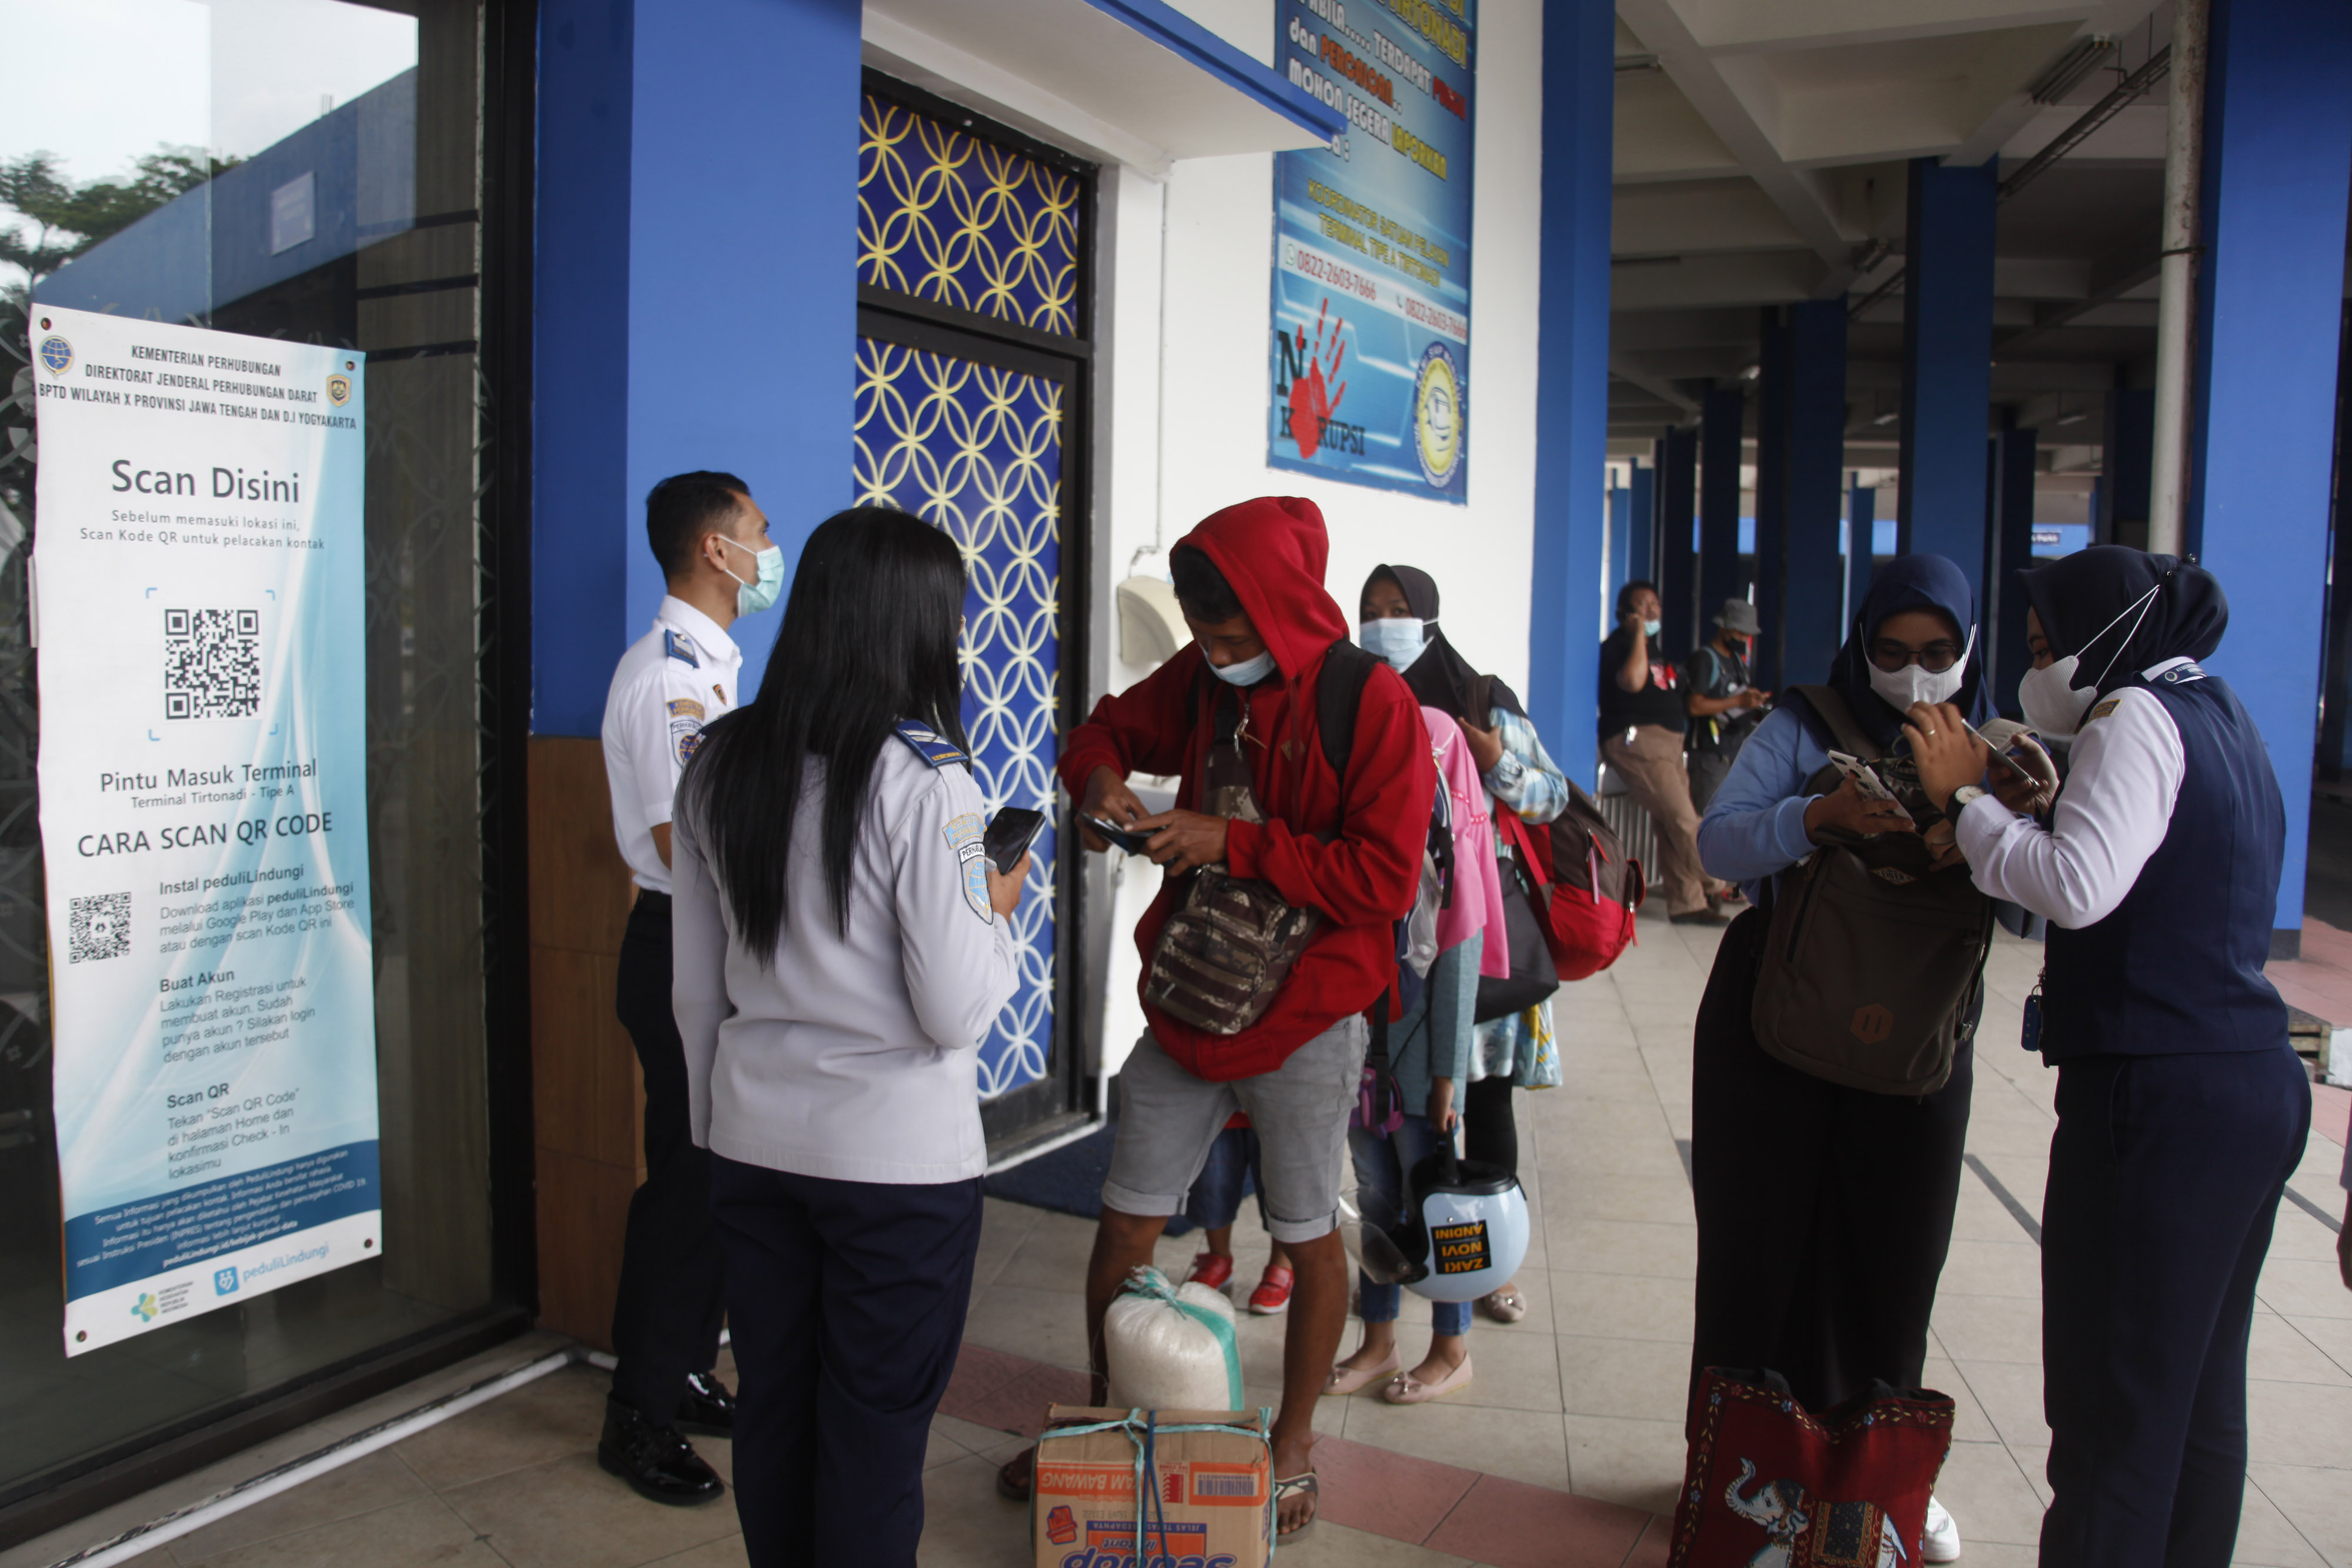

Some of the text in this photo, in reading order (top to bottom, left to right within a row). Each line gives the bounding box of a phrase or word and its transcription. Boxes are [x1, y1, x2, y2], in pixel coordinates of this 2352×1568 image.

[1289, 15, 1317, 57] dan
[1374, 29, 1431, 95] TERDAPAT
[1289, 58, 1343, 113] MOHON
[1347, 93, 1389, 145] SEGERA
[1392, 122, 1447, 182] LAPORKAN
[1308, 178, 1378, 233] KOORDINATOR
[1381, 216, 1412, 249] SATUAN
[1319, 212, 1441, 288] TERMINAL TIPE A TIRTONADI
[1298, 250, 1377, 300] 0822-2603-7666
[132, 345, 281, 376] KEMENTERIAN PERHUBUNGAN
[86, 364, 318, 403] DIREKTORAT JENDERAL PERHUBUNGAN DARAT
[39, 383, 356, 429] BPTD WILAYAH X PROVINSI JAWA TENGAH DAN D.I YOGYAKARTA
[1280, 406, 1365, 456] KRUPSI
[112, 460, 299, 503] Scan Disini
[80, 528, 325, 549] Scan Kode QR untuk pelacakan kontak
[112, 510, 300, 531] Sebelum memasuki lokasi ini,
[101, 759, 316, 792] Pintu Masuk Terminal
[131, 784, 295, 808] Terminal Tirtonadi Tipe A
[78, 812, 333, 857] CARA SCAN QR CODE
[160, 864, 304, 895] Instal peduliLindungi
[160, 882, 353, 920] Download aplikasi peduliLindungi
[160, 898, 355, 937] melalui Google Play dan App Store
[160, 917, 332, 954] atau dengan scan Kode QR ini
[160, 970, 235, 992] Buat Akun
[160, 977, 306, 1012] Lakukan Registrasi untuk
[161, 996, 293, 1029] membuat akun. Sudah
[162, 1007, 316, 1048] punya akun ? Silakan login
[163, 1029, 289, 1064] dengan akun tersebut
[167, 1082, 229, 1108] Scan QR
[168, 1112, 203, 1130] Tekan
[243, 1096, 262, 1111] QR
[168, 1106, 294, 1146] di halaman Home dan
[168, 1124, 290, 1164] konfirmasi Check In
[169, 1158, 221, 1179] lokasimu
[1435, 1223, 1484, 1240] ANDINI
[1442, 1241, 1482, 1258] NOVI
[243, 1242, 329, 1283] peduliLindungi
[1445, 1257, 1484, 1273] ZAKI
[1041, 1472, 1107, 1490] BAWANG
[1102, 1537, 1157, 1552] Intant
